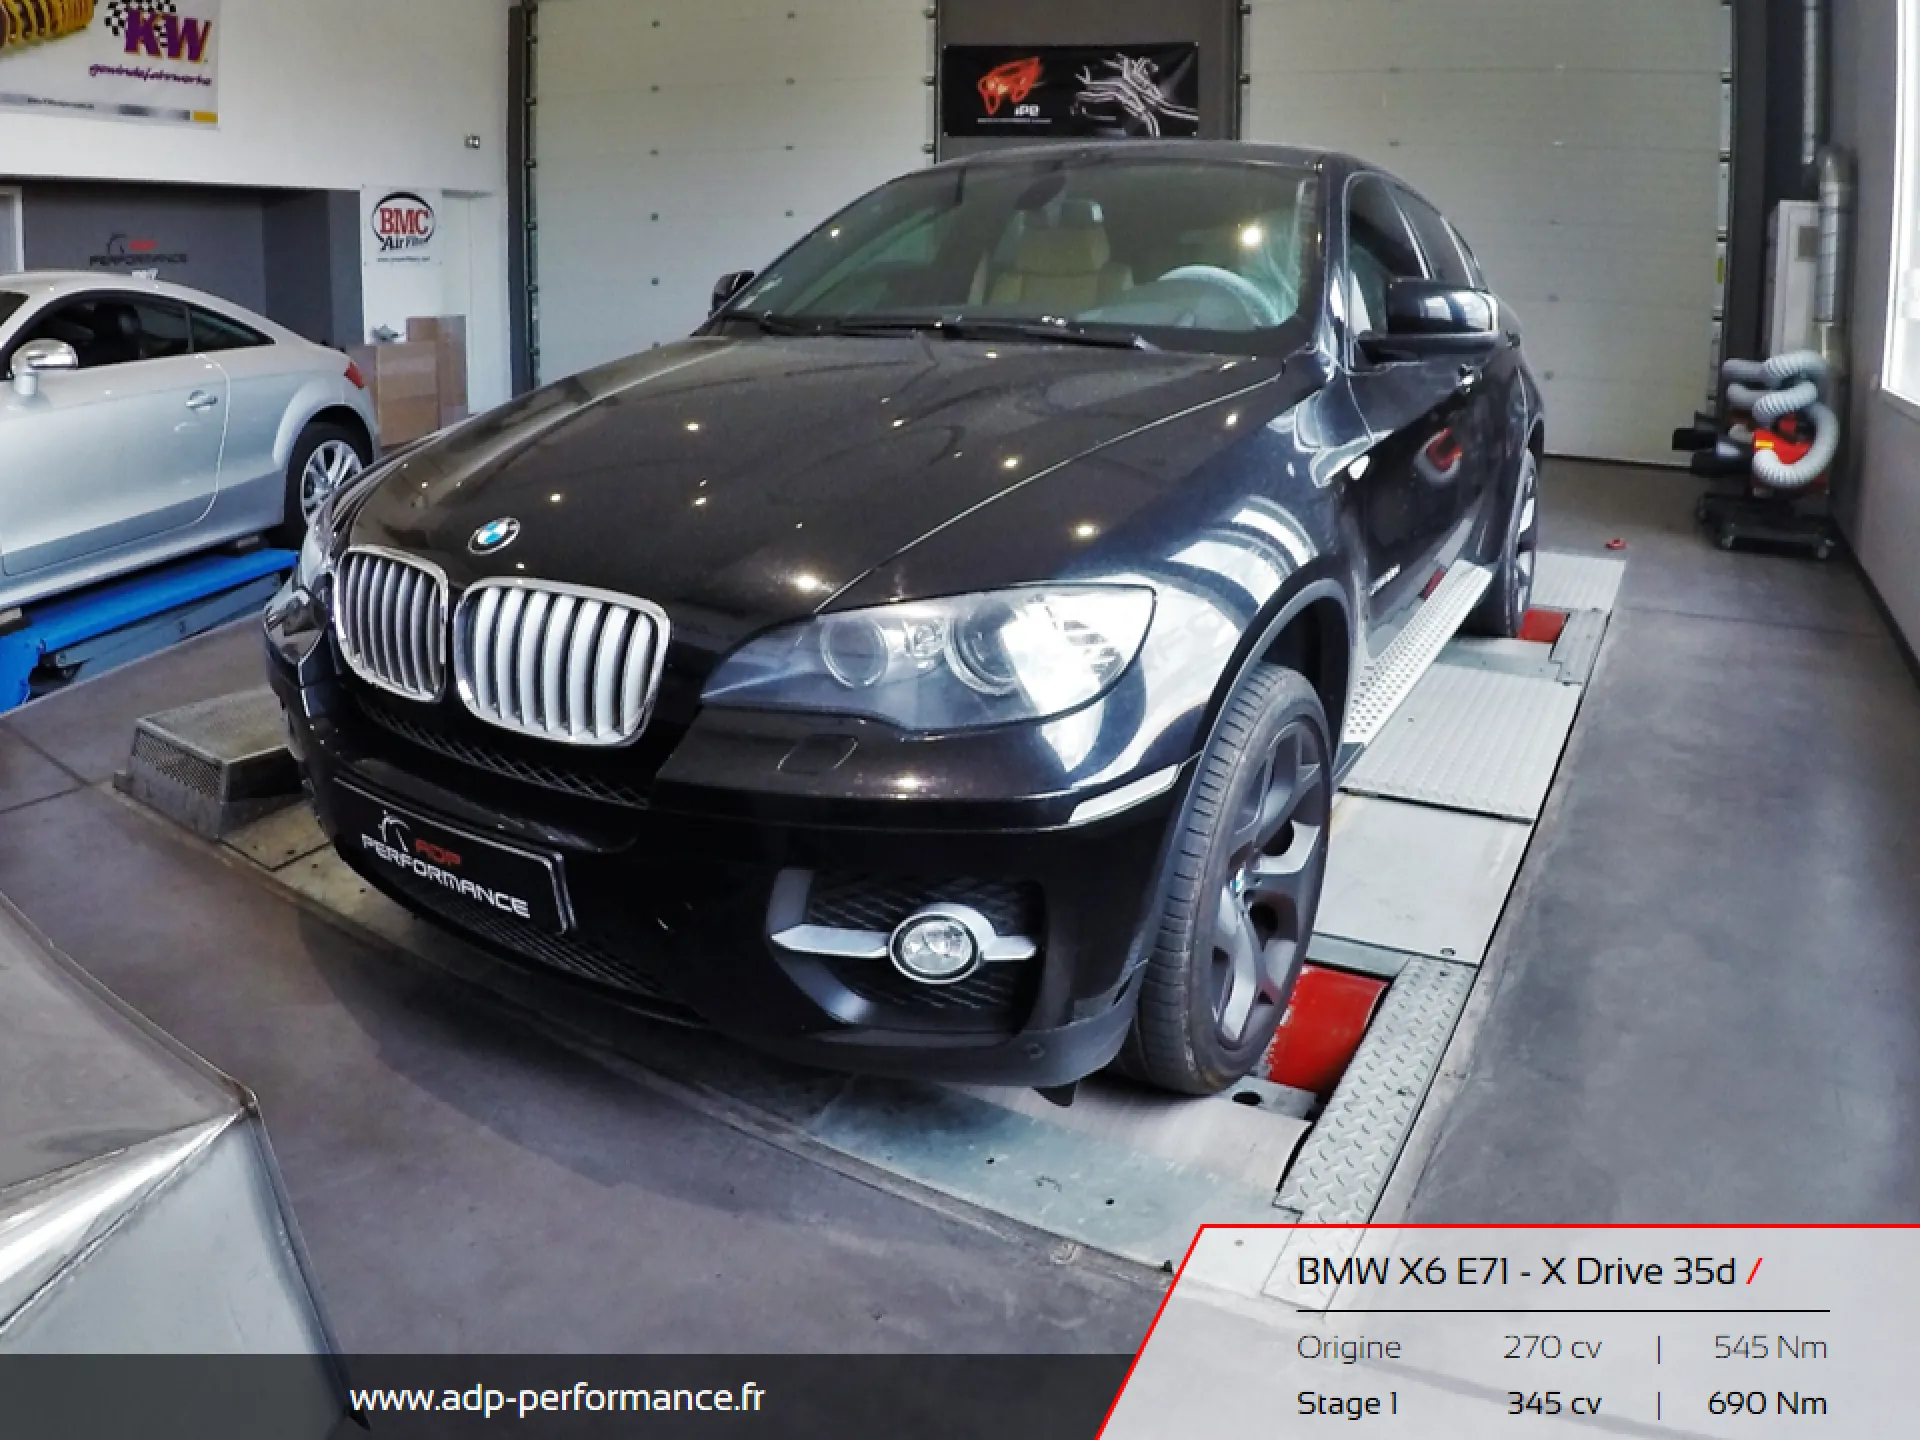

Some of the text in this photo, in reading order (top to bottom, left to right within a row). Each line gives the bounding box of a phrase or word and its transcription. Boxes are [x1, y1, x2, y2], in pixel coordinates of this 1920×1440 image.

[124, 9, 212, 63] KW
[380, 208, 429, 235] BMC
[380, 235, 405, 252] Air
[361, 833, 531, 919] PERFORMANCE
